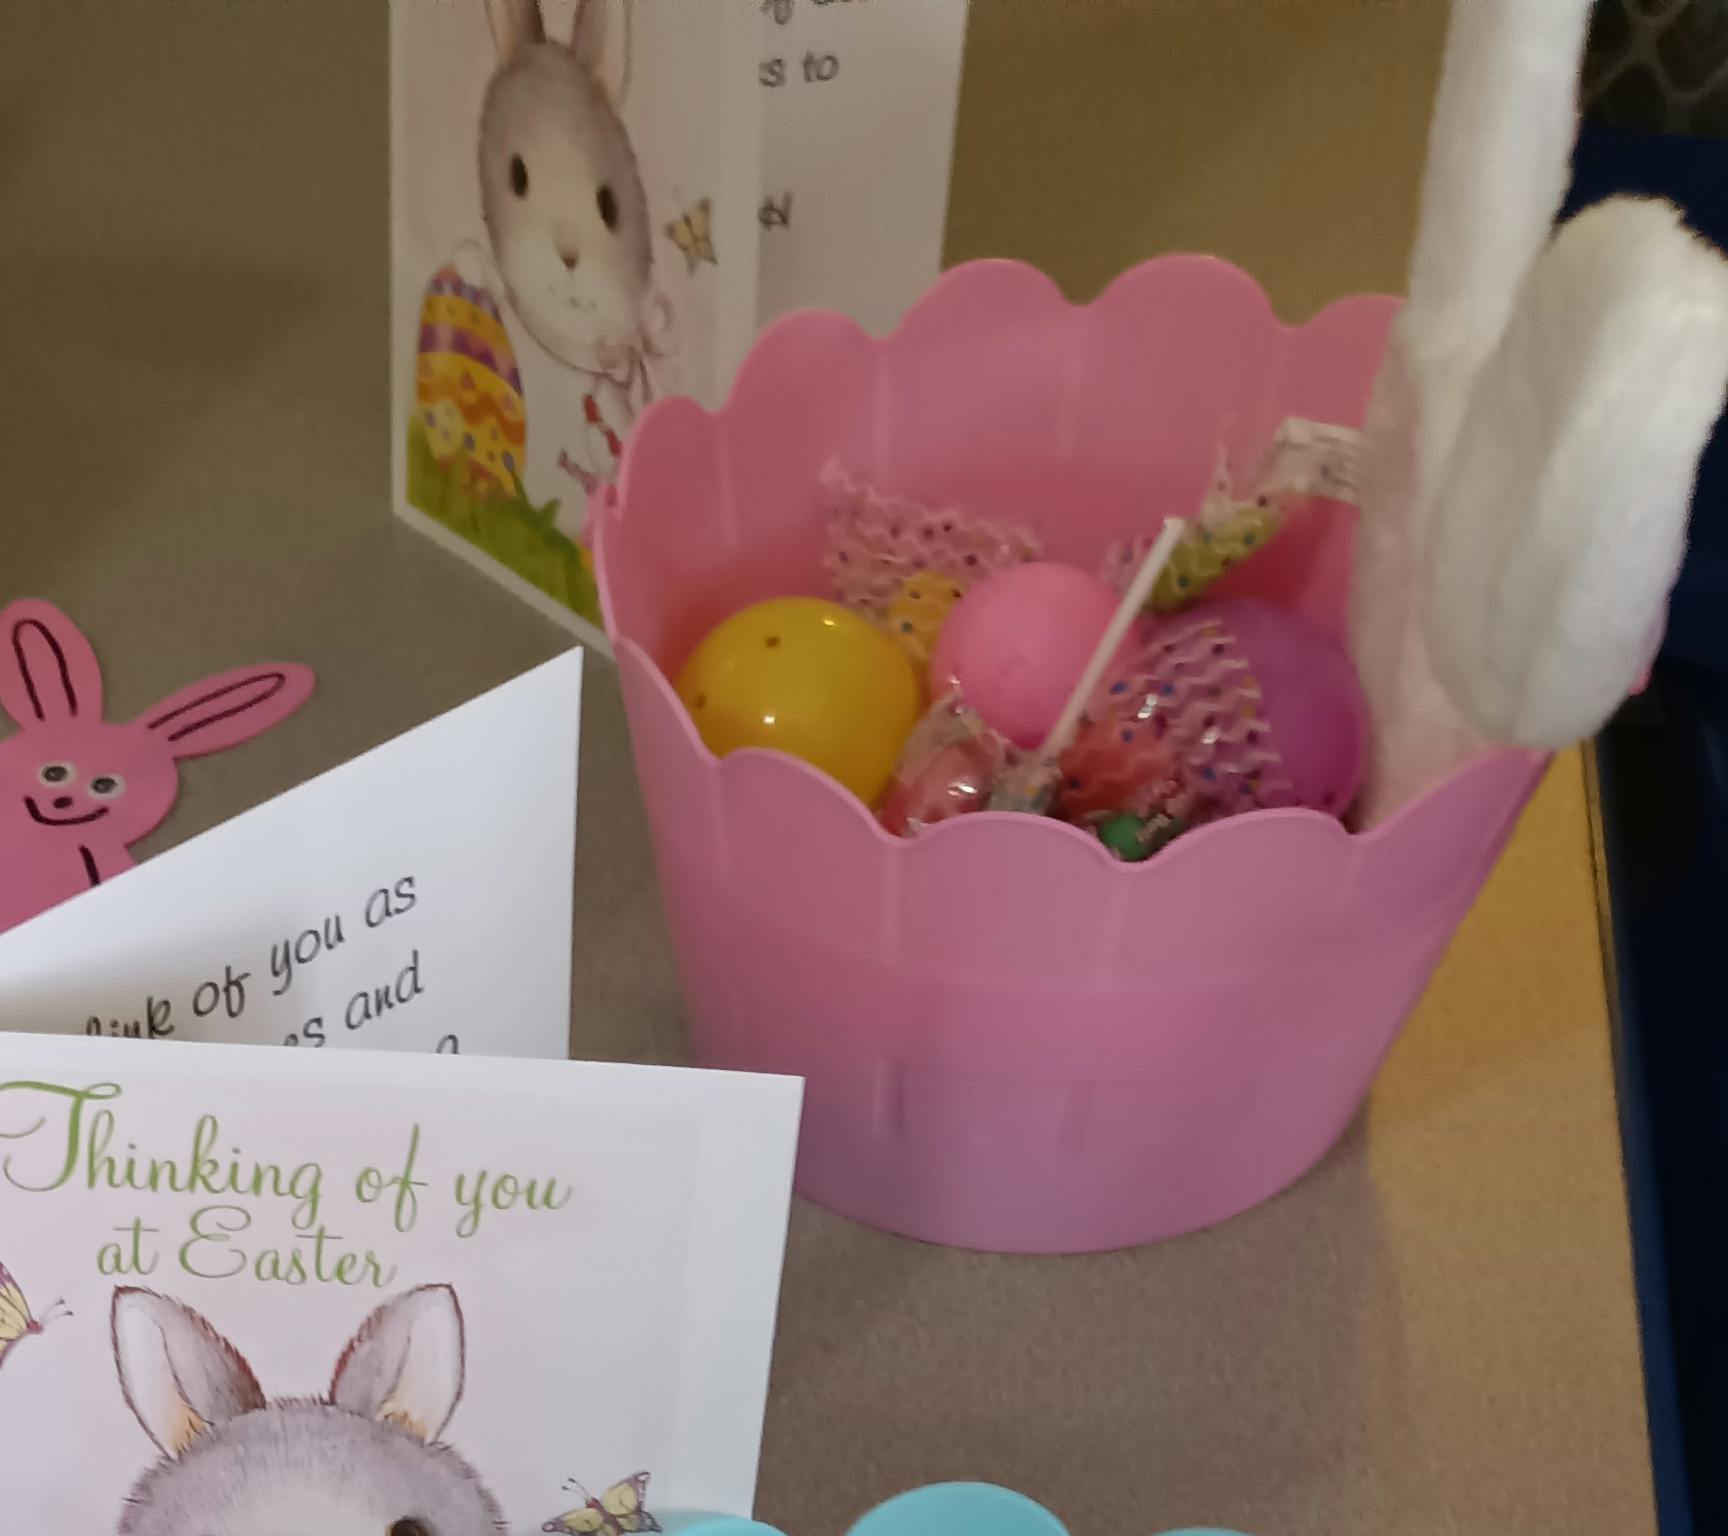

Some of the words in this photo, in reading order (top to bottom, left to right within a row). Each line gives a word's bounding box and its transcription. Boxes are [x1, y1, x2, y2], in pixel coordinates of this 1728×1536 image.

[801, 48, 840, 83] to
[192, 966, 251, 1018] of
[272, 914, 345, 996] you
[365, 876, 418, 928] as
[345, 949, 425, 1031] and
[355, 1123, 429, 1233] of
[455, 1167, 574, 1238] you
[97, 1216, 161, 1276] at
[178, 1204, 398, 1288] Easter
